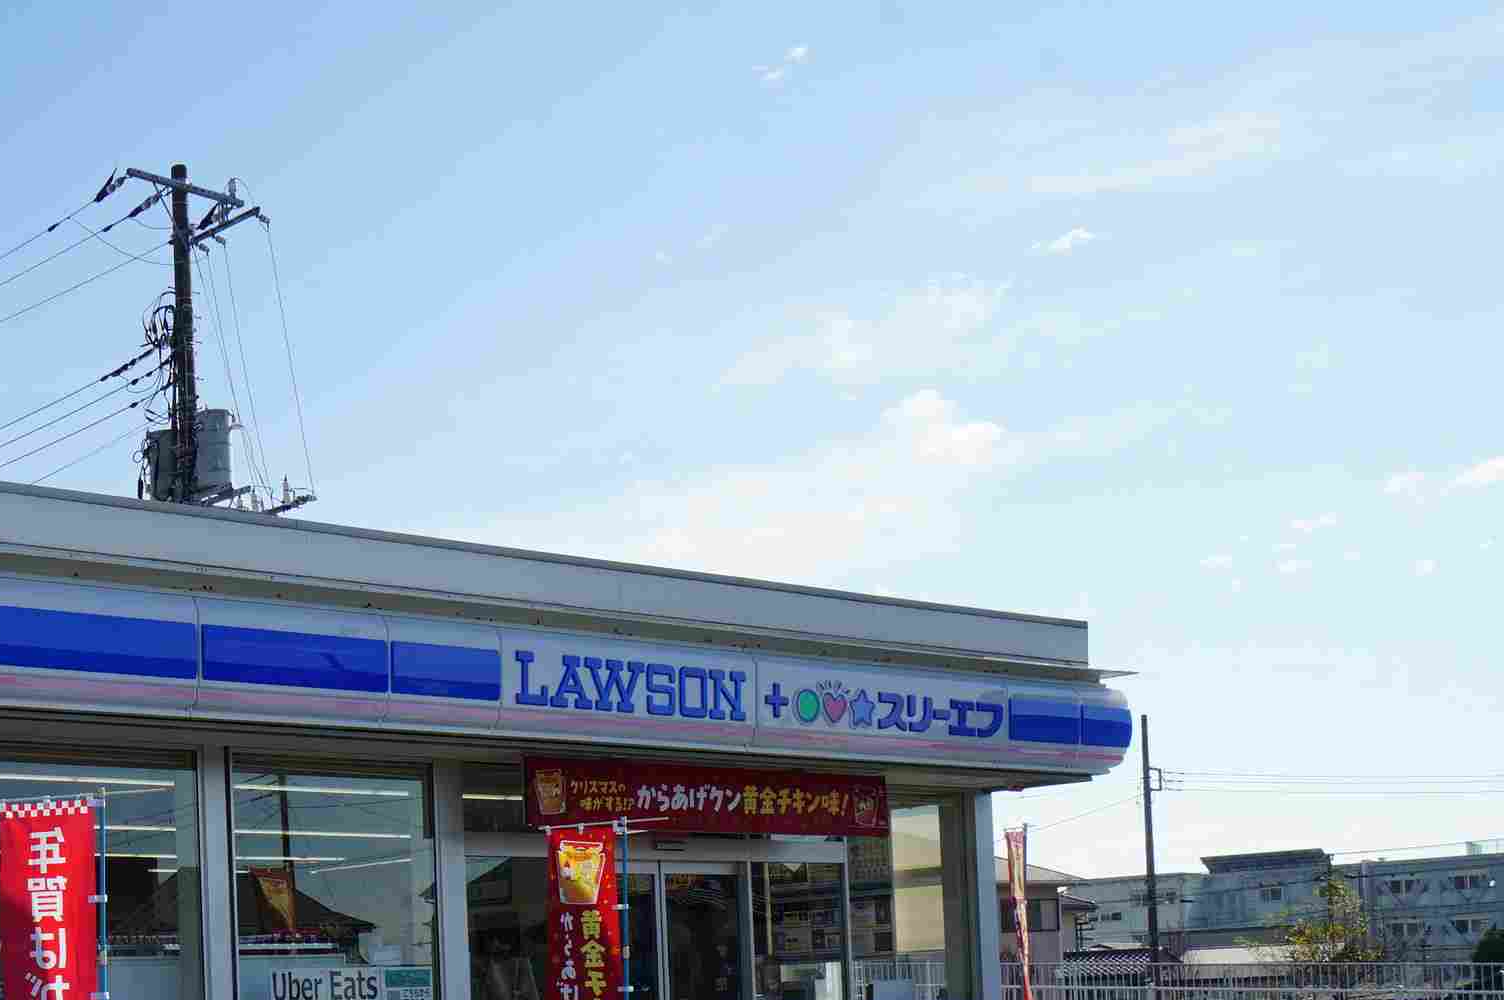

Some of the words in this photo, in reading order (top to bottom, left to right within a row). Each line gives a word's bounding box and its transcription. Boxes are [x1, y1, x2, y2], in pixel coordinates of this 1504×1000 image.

[515, 650, 746, 721] LAWSON
[877, 691, 1004, 738] スリーエフ
[569, 779, 627, 794] クリスマスの
[272, 971, 323, 1000] Uber
[330, 970, 378, 1000] Eats
